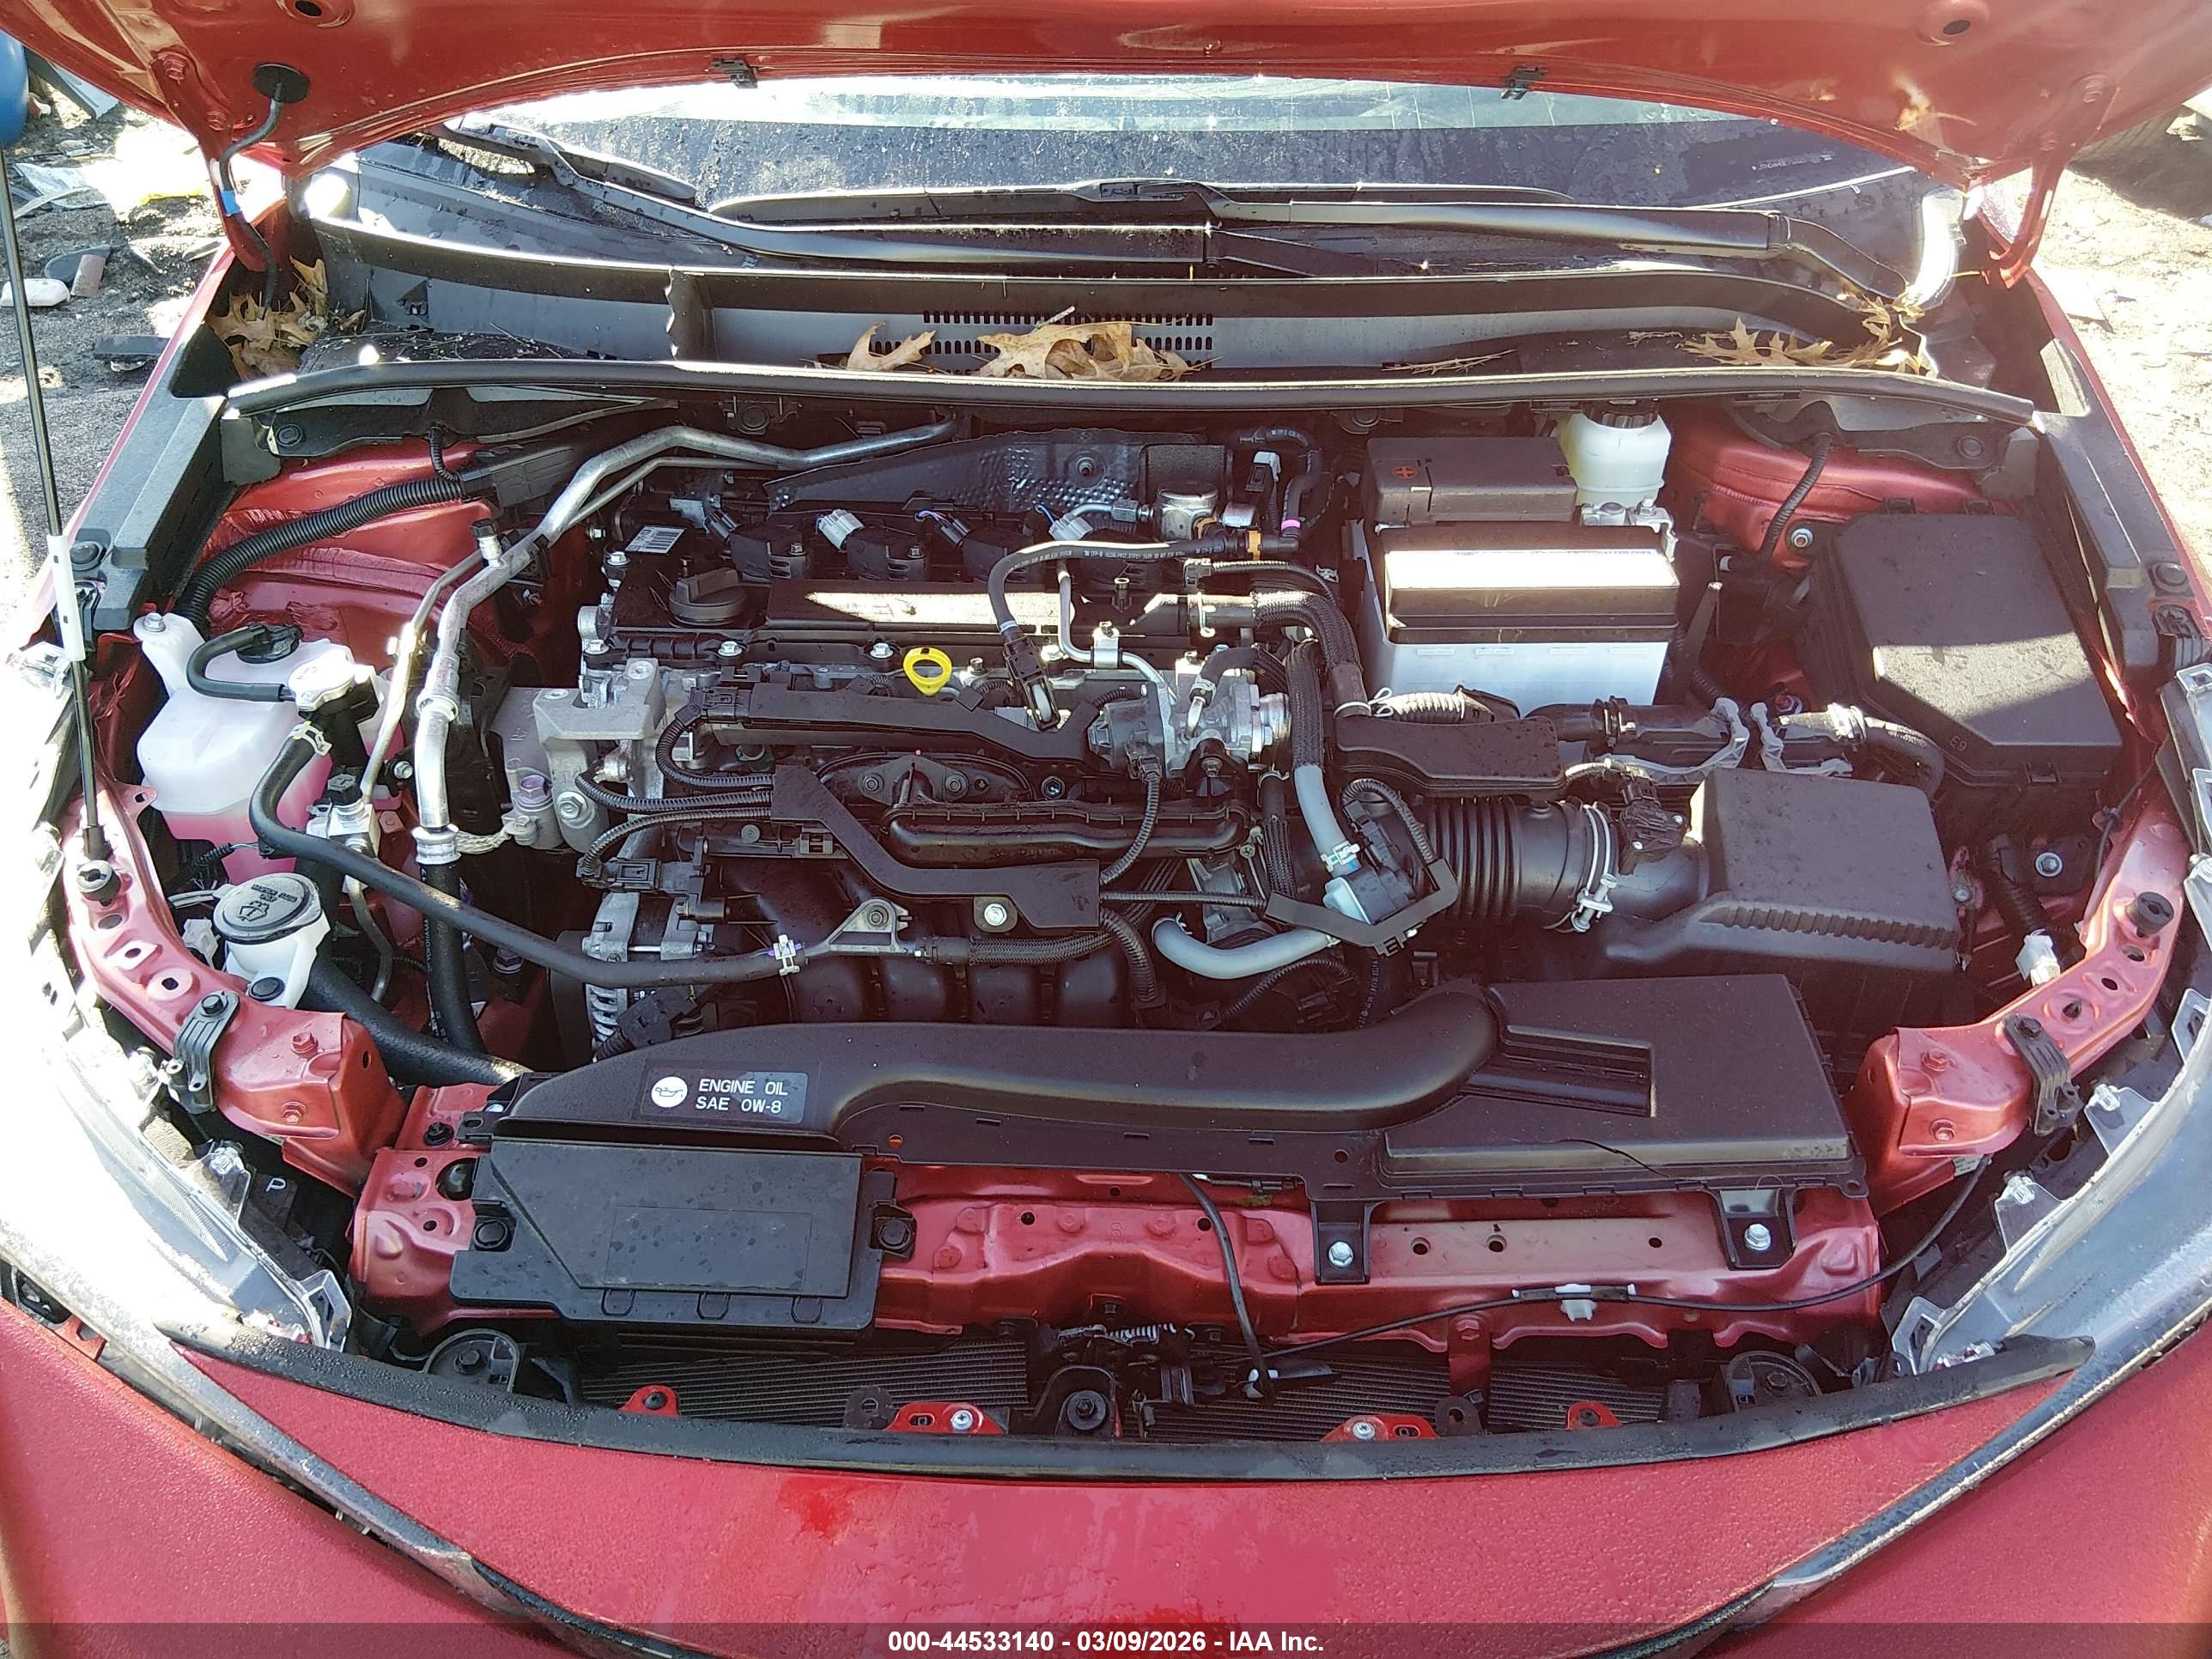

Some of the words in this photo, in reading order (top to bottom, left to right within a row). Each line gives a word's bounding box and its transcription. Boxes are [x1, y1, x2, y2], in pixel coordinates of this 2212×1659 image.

[698, 1078, 756, 1094] ENGINE
[765, 1081, 788, 1096] OIL
[696, 1096, 730, 1111] SAE
[741, 1098, 782, 1114] 0W-8
[265, 1177, 287, 1193] P
